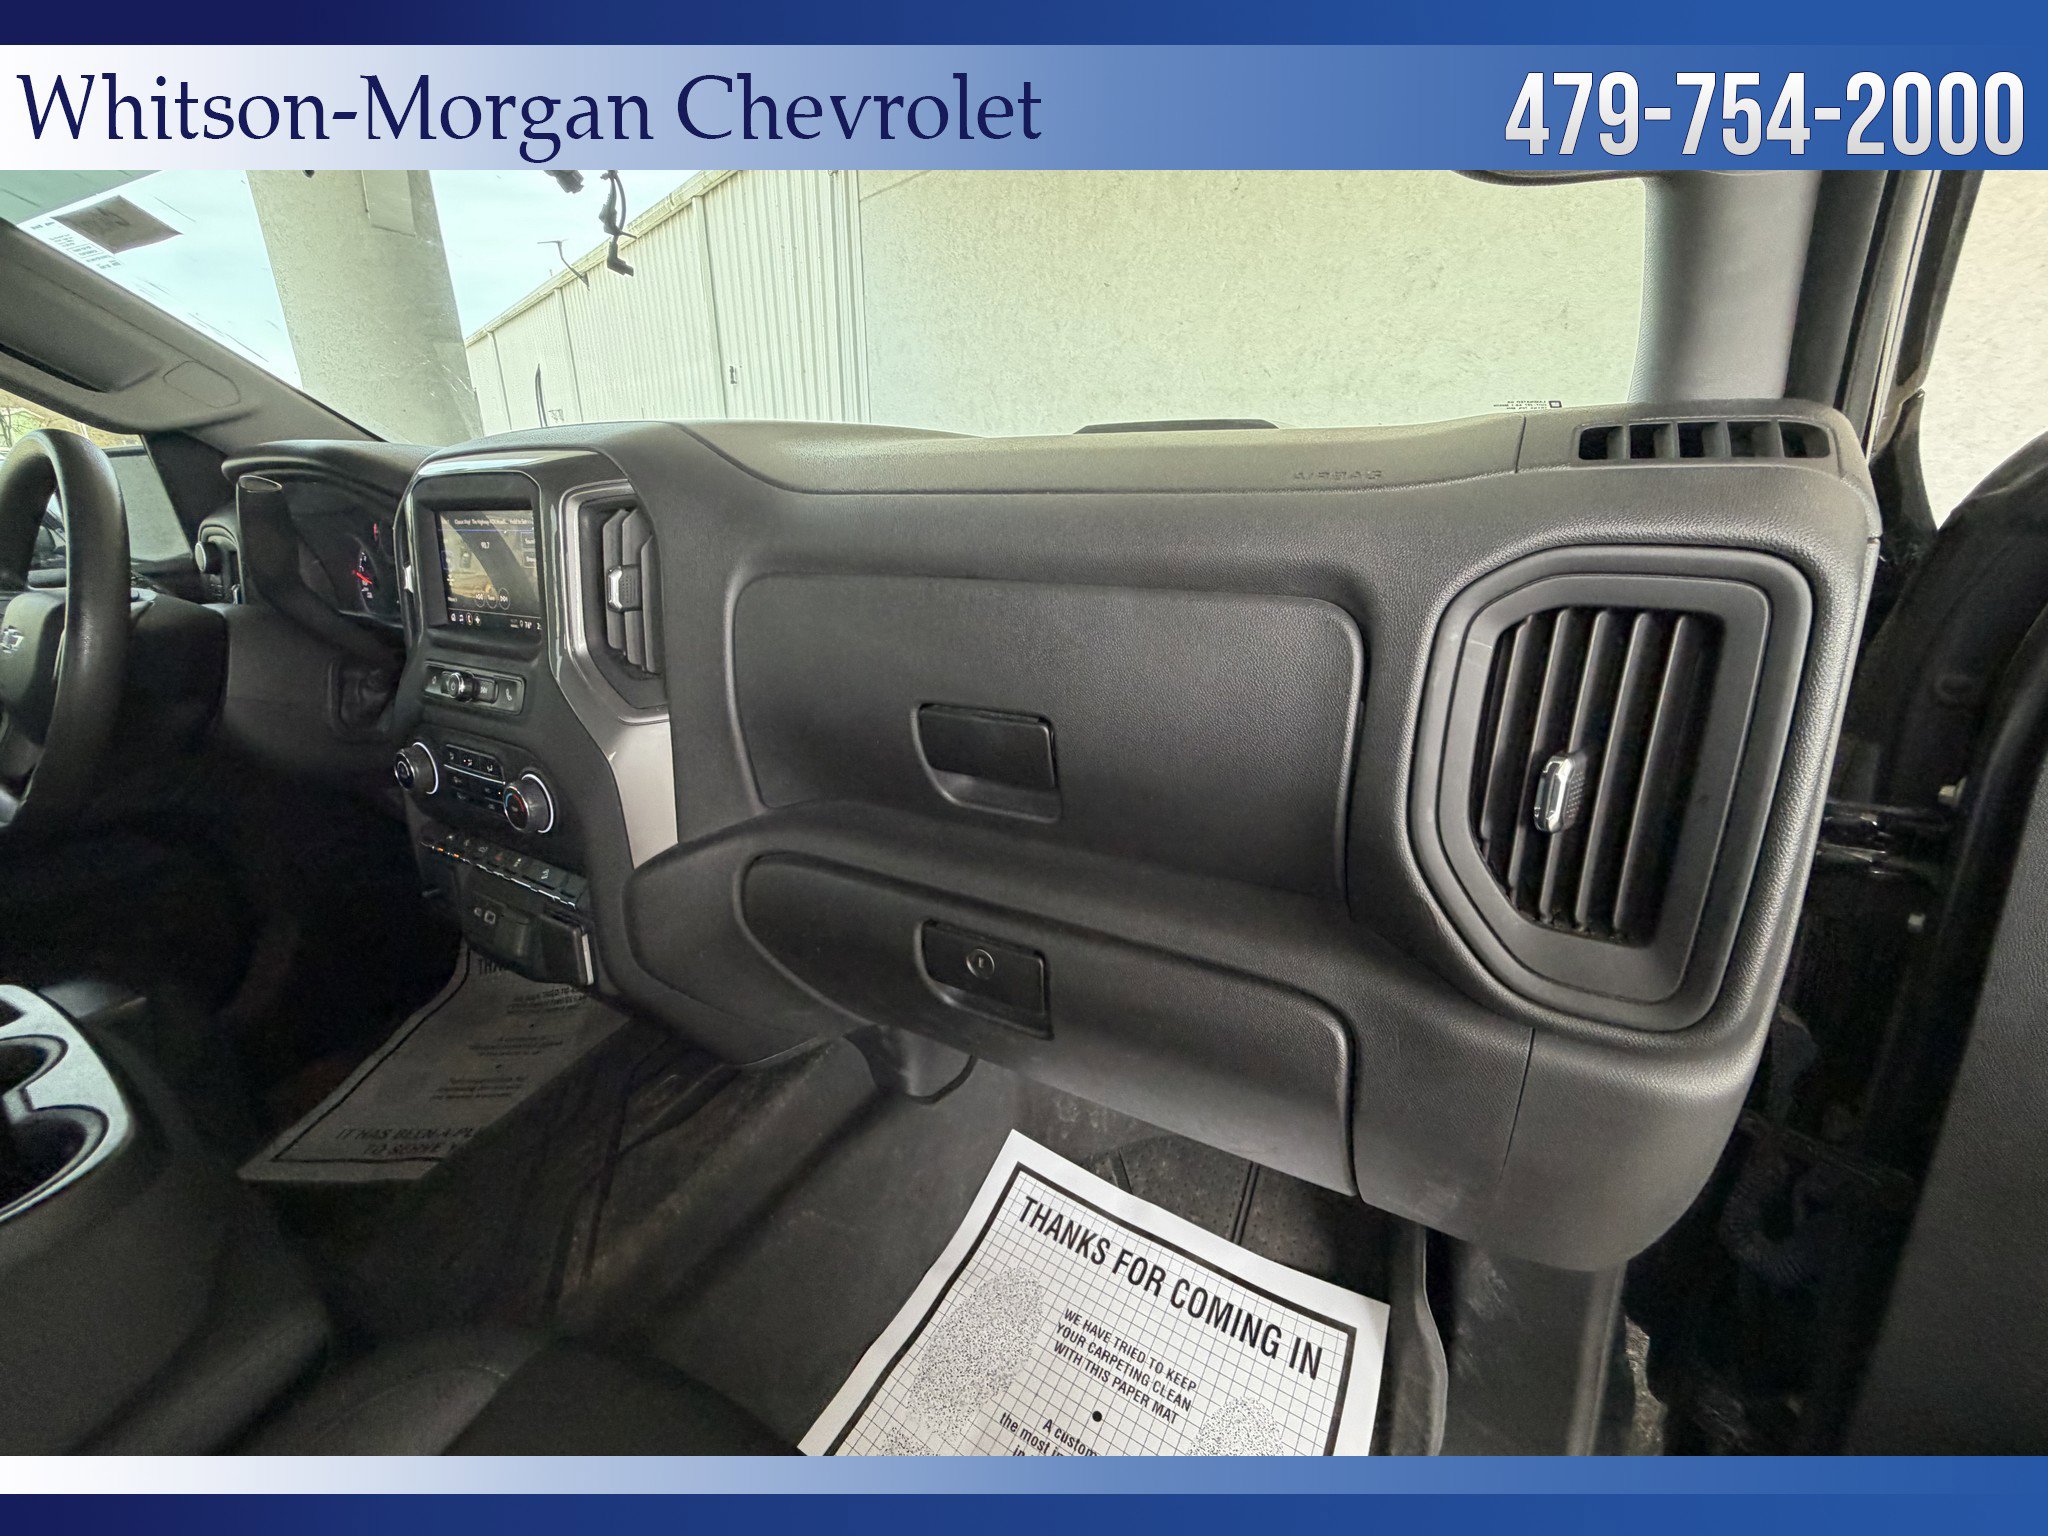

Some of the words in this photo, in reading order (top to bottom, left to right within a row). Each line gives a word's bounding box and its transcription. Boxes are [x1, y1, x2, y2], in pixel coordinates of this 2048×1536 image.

[1019, 1196, 1111, 1265] THANKS
[1112, 1248, 1166, 1297] FOR
[1170, 1278, 1282, 1359] COMING
[1289, 1337, 1323, 1380] IN
[1053, 1341, 1082, 1365] WITH
[1083, 1358, 1111, 1382] THIS
[1112, 1378, 1151, 1408] PAPER
[1152, 1401, 1180, 1425] MAT
[1056, 1322, 1086, 1348] YOUR
[1088, 1342, 1151, 1386] CARPETING
[1152, 1380, 1192, 1412] CLEAN
[1064, 1308, 1082, 1325] WE
[1082, 1319, 1112, 1344] HAVE
[1113, 1336, 1146, 1363] TRIED
[1149, 1356, 1164, 1374] TO
[1165, 1369, 1197, 1392] KEEP
[999, 1412, 1018, 1433] the
[1019, 1428, 1050, 1455] most
[1042, 1419, 1053, 1433] A
